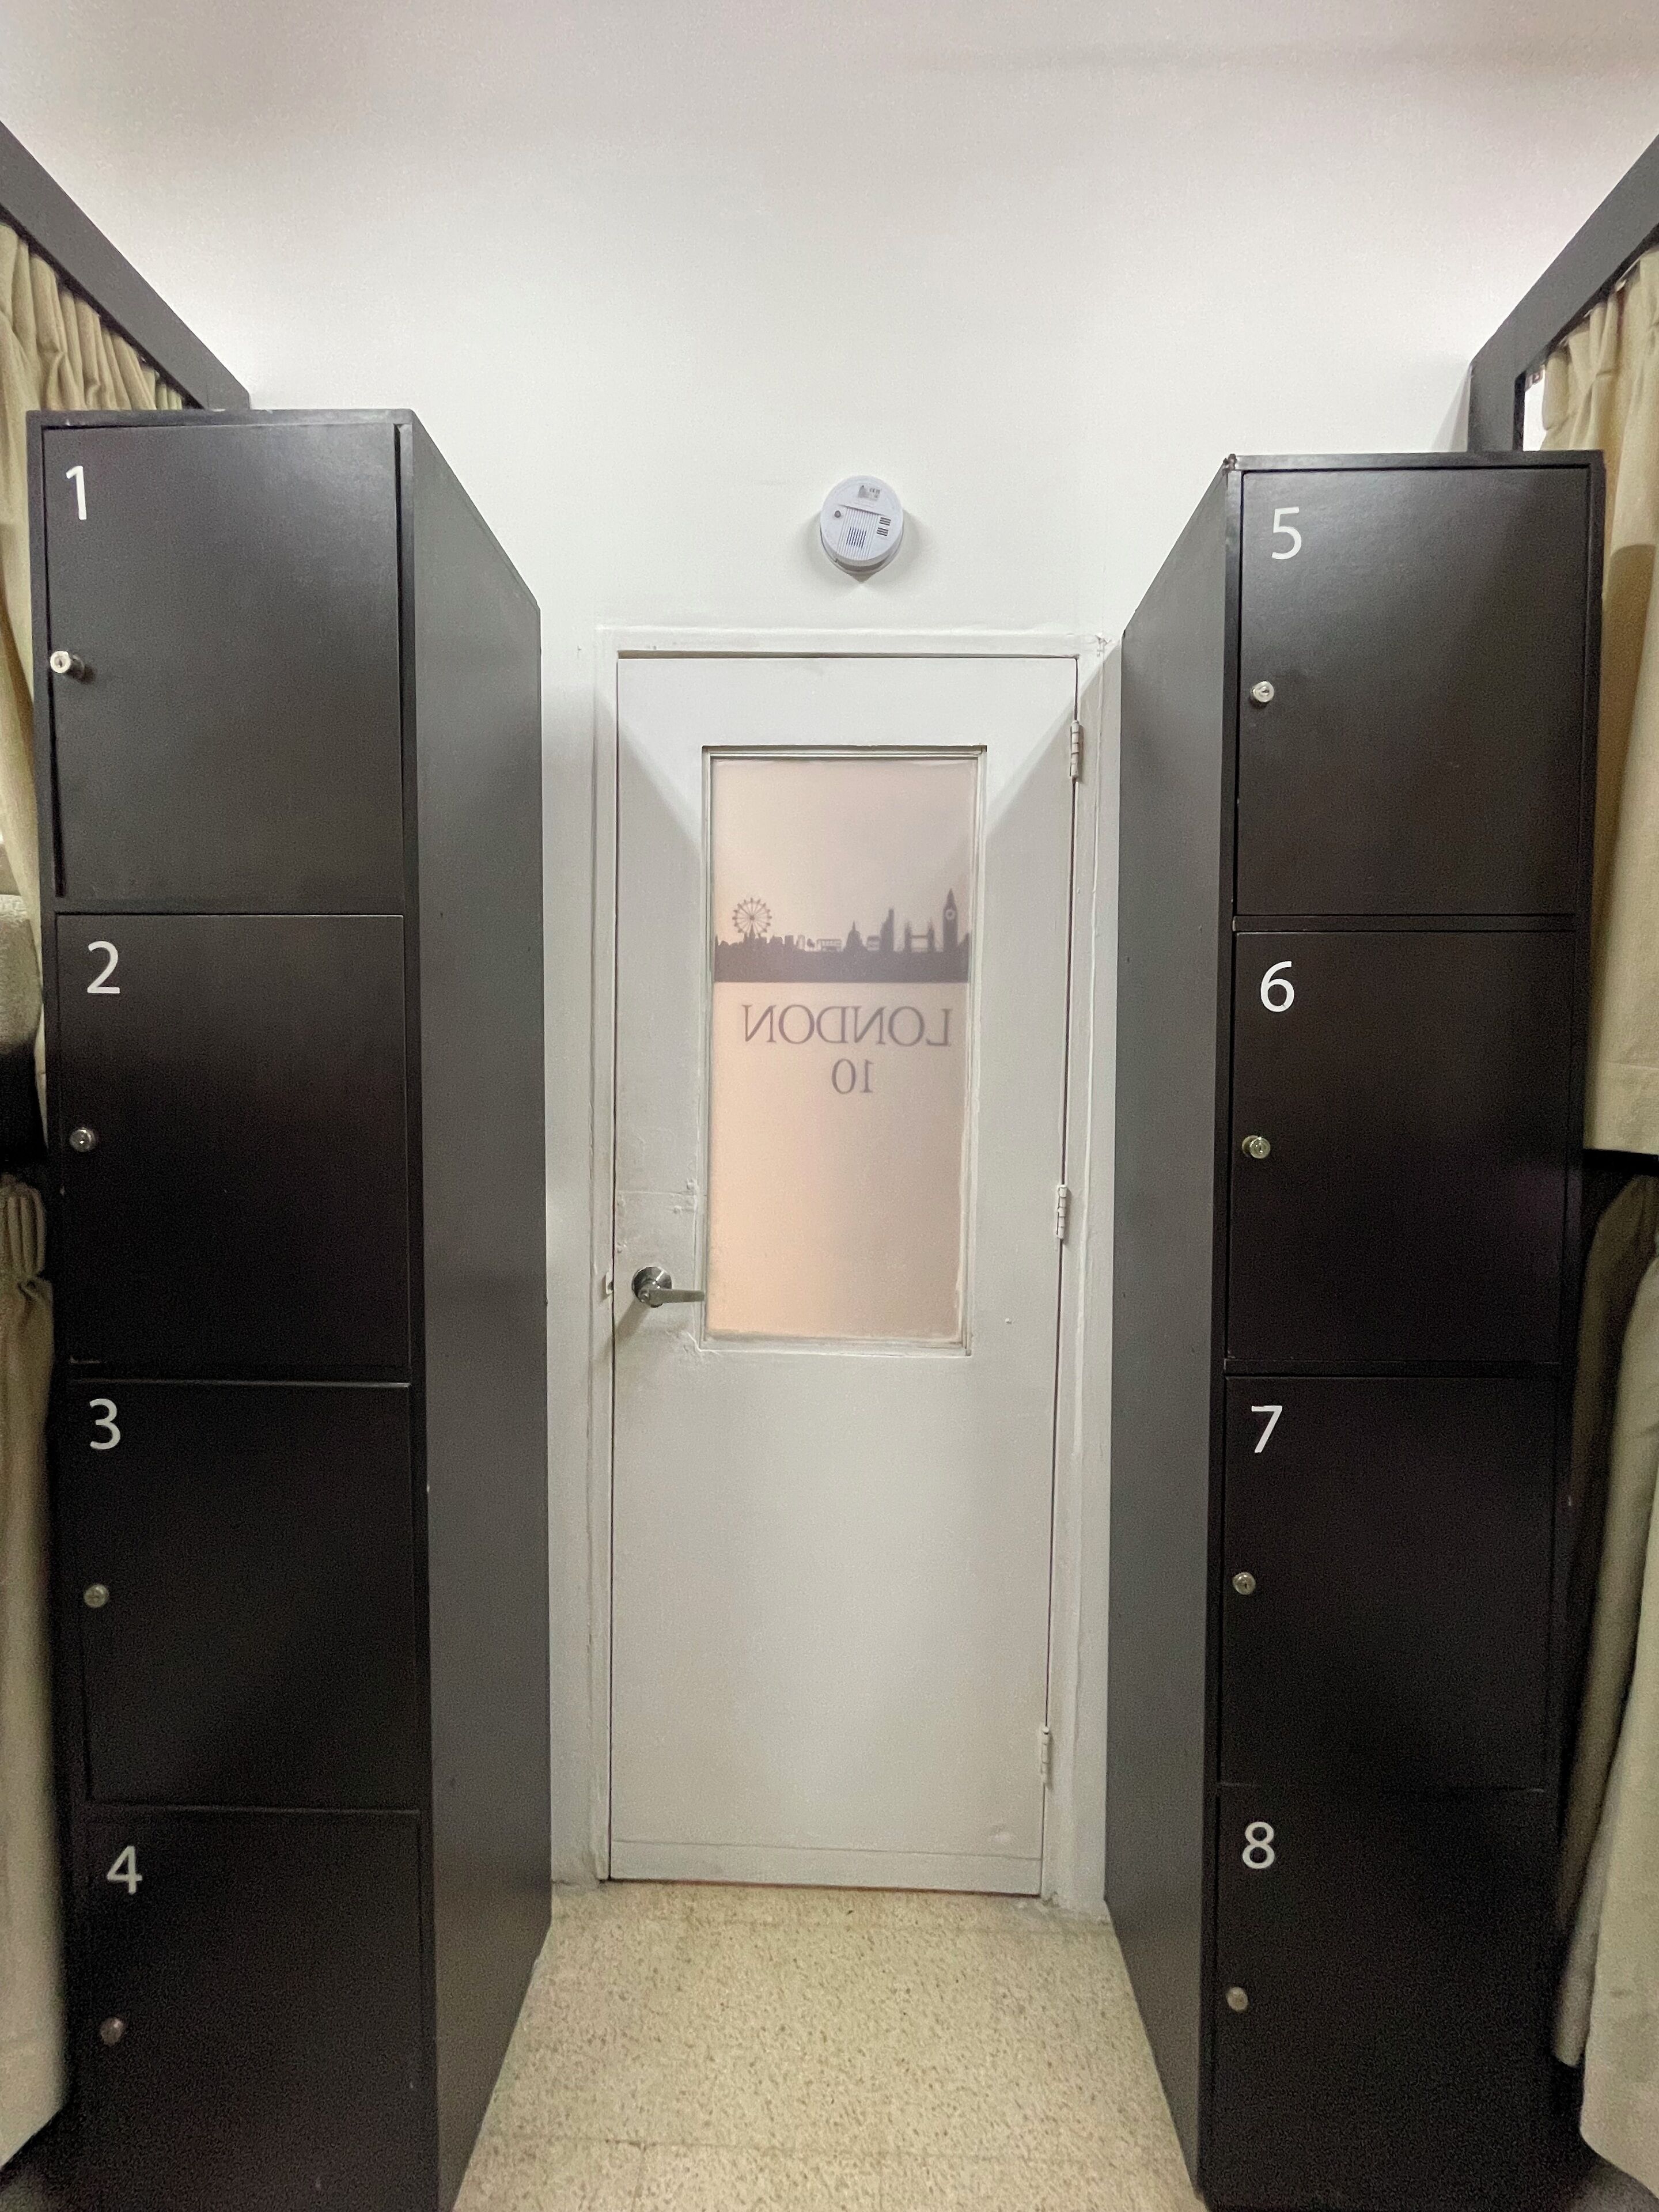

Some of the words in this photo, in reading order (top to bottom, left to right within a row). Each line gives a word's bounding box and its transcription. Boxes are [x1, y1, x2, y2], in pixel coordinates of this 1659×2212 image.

[65, 465, 87, 521] 1
[1271, 506, 1302, 560] 5
[86, 941, 120, 994] 2
[1260, 960, 1295, 1013] 6
[89, 1398, 120, 1450] 3
[1251, 1405, 1283, 1453] 7
[107, 1846, 142, 1893] 4
[1242, 1821, 1275, 1869] 8
